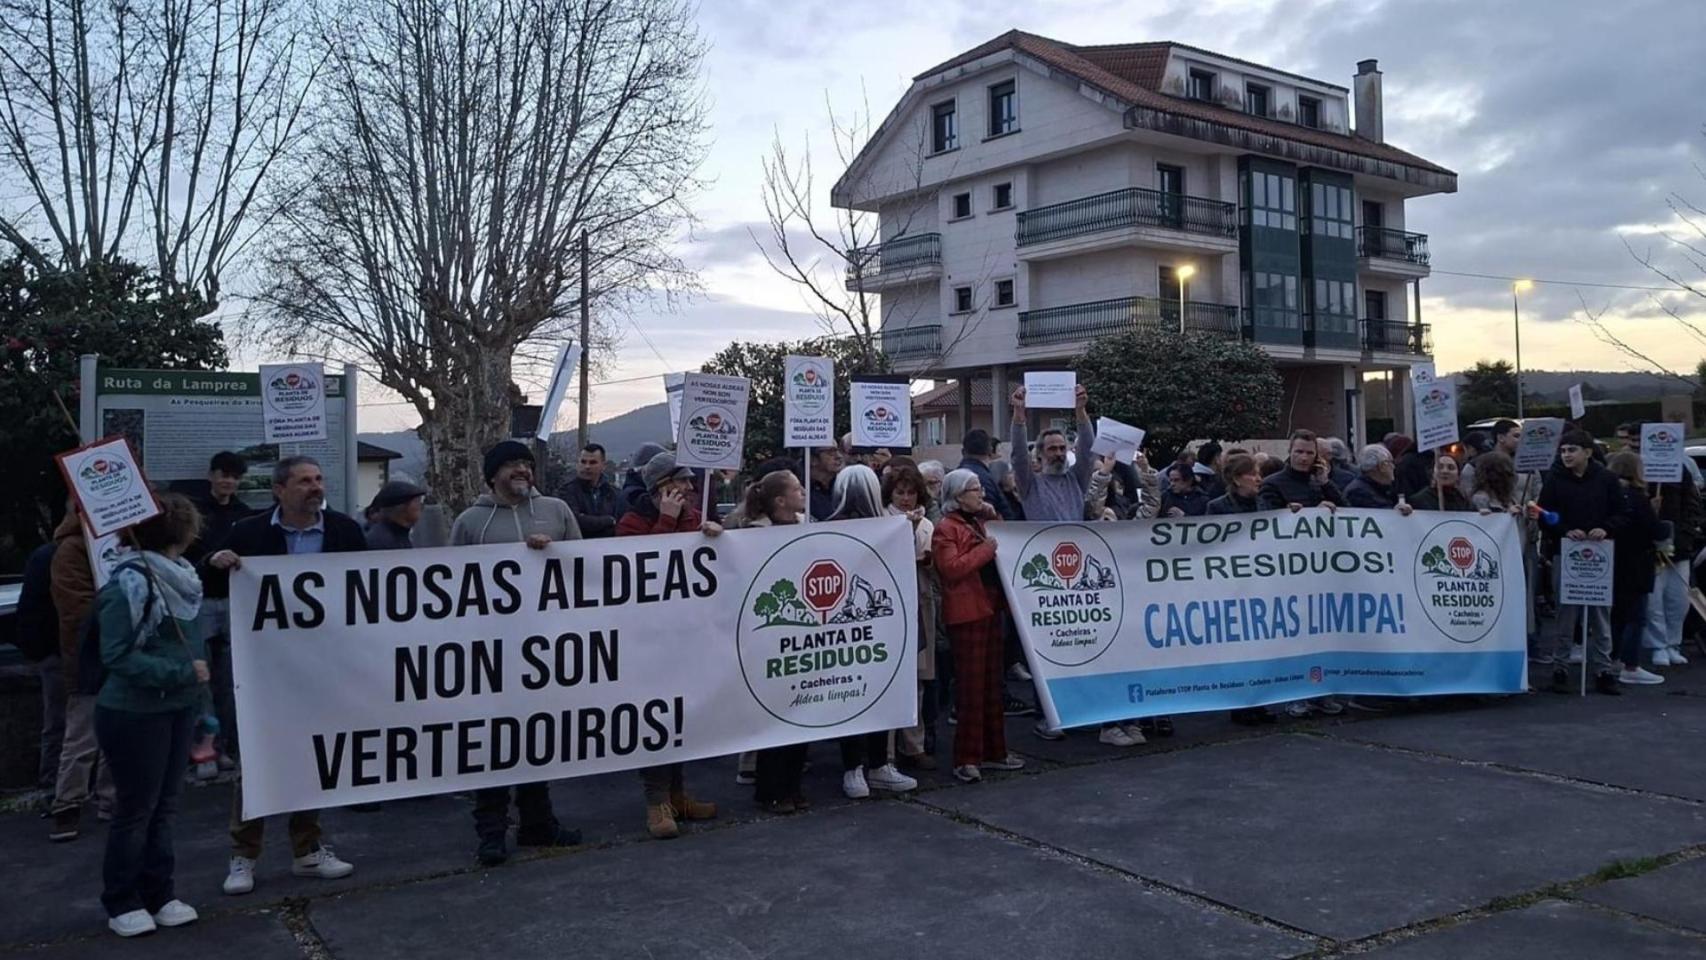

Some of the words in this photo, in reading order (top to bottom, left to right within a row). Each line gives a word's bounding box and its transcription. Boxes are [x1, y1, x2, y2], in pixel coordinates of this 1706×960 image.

[104, 376, 142, 389] Ruta
[153, 378, 172, 390] da
[182, 379, 248, 392] Lamprea
[690, 439, 731, 448] RESIDUOS
[1150, 521, 1242, 546] STOP
[1250, 515, 1383, 541] PLANTA
[1056, 554, 1078, 567] STOP
[1452, 546, 1470, 558] STOP
[1146, 557, 1194, 582] DE
[1204, 551, 1394, 580] RESIDUOS!
[252, 571, 325, 631] AS
[345, 559, 521, 626] NOSAS
[538, 546, 717, 611] ALDEAS
[808, 575, 841, 597] STOP
[1437, 581, 1476, 592] PLANTA
[1478, 582, 1489, 592] DE
[1038, 594, 1083, 608] PLANTA
[1086, 592, 1100, 604] DE
[1432, 594, 1494, 608] RESIDUOS
[1032, 608, 1112, 627] RESIDUOS
[1144, 594, 1300, 648] CACHEIRAS
[1308, 592, 1406, 635] LIMPA!
[780, 628, 846, 653] PLANTA
[851, 626, 874, 642] DE
[1056, 628, 1090, 638] Cacheiras
[395, 639, 502, 702] NON
[521, 629, 619, 690] SON
[766, 642, 888, 679] RESIDUOS
[800, 674, 853, 690] Cacheiras
[790, 692, 824, 708] Aldeas
[312, 697, 684, 791] VERTEDOIROS!
